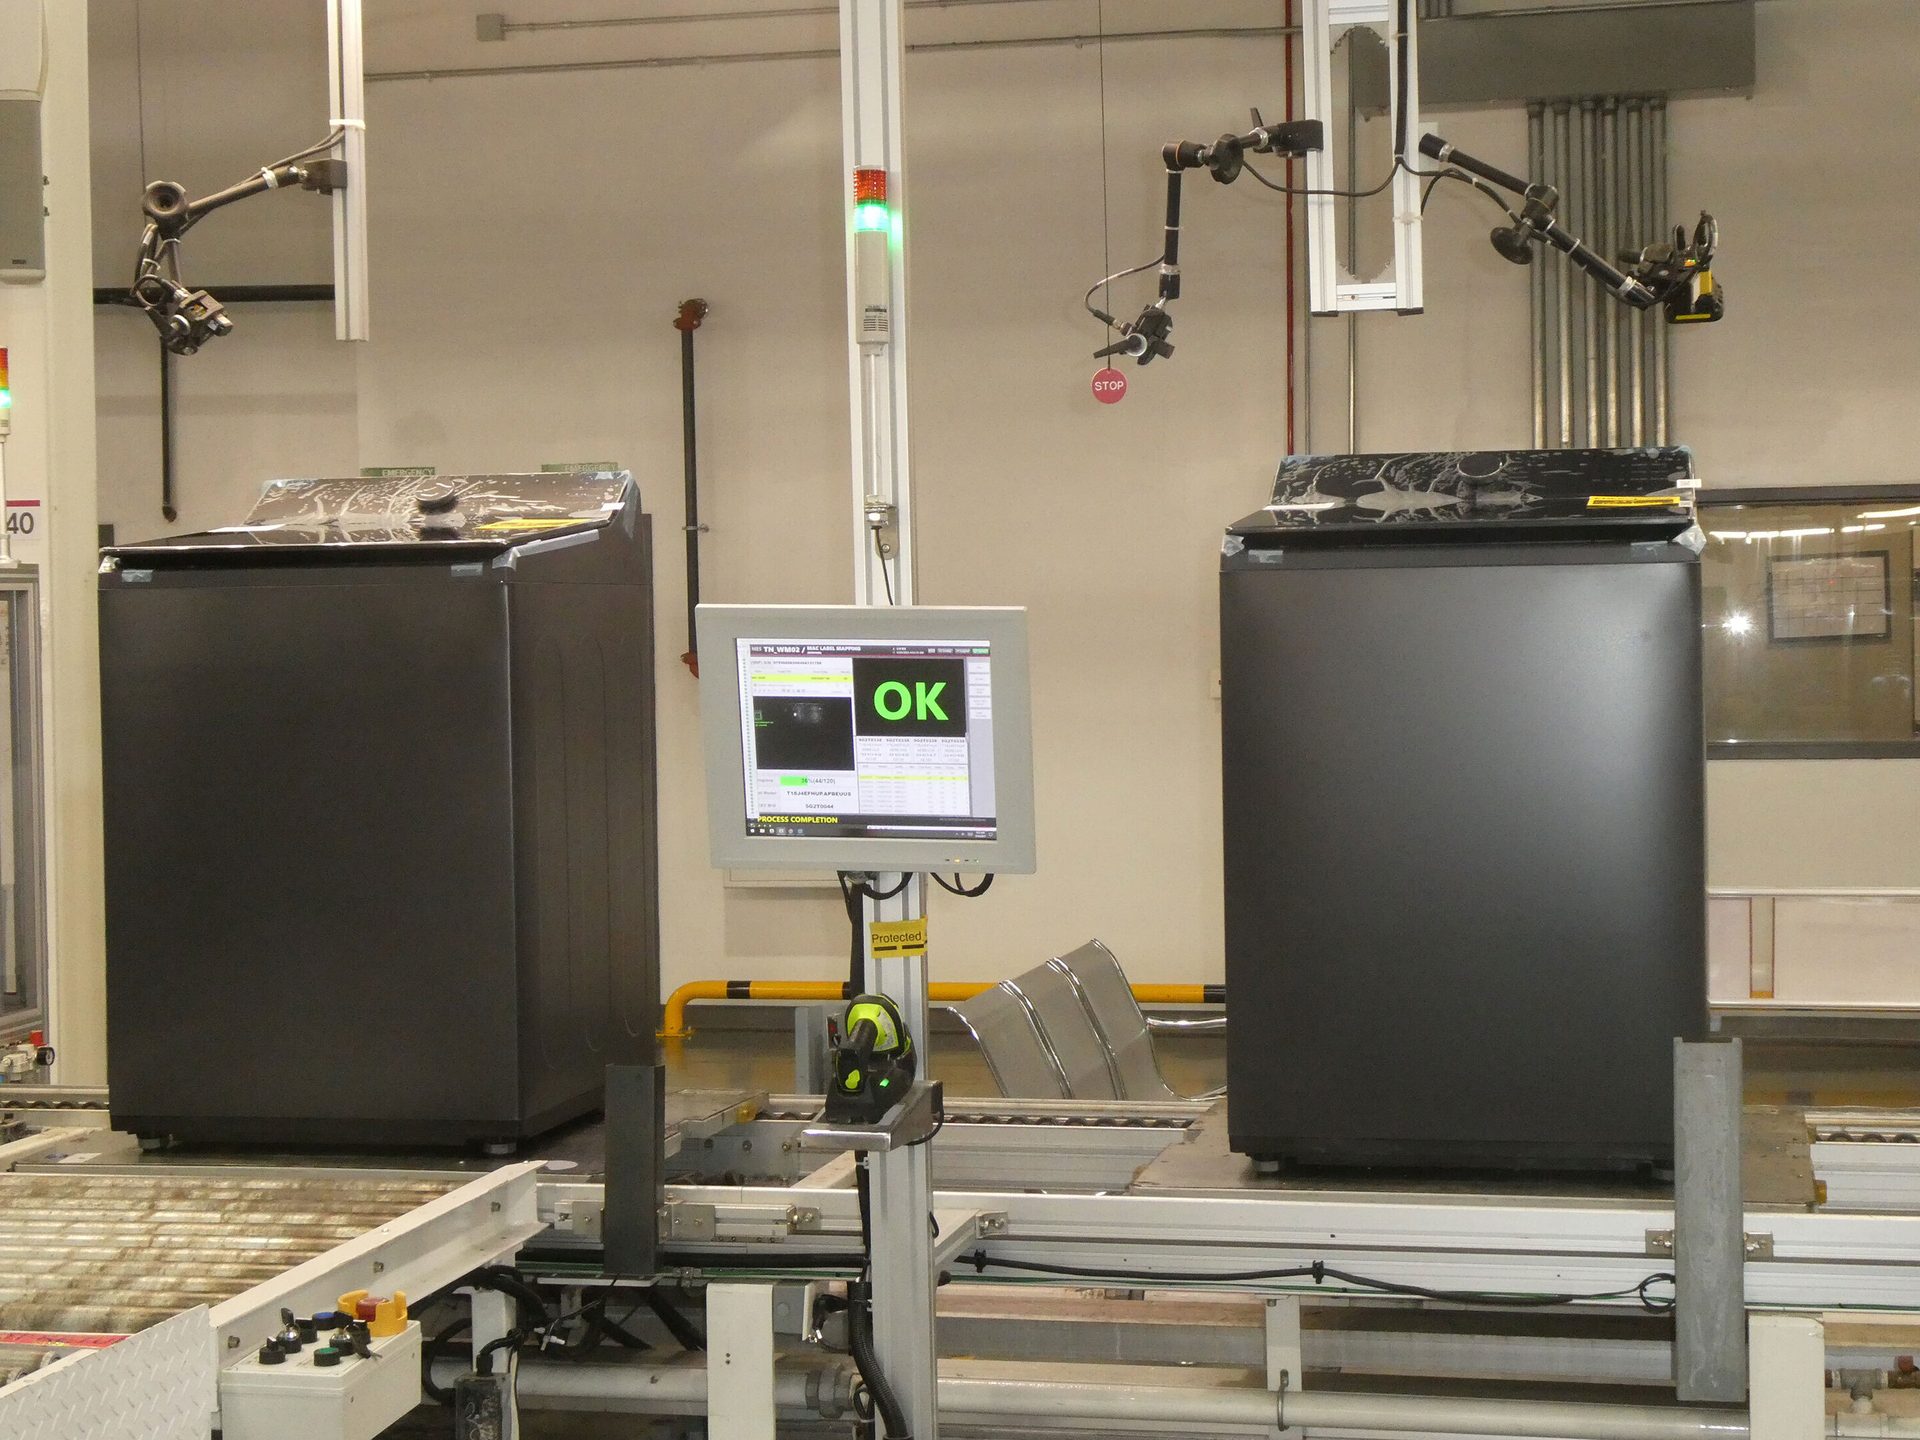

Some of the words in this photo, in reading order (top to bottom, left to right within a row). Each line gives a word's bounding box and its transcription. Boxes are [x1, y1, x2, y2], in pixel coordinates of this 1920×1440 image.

[1094, 380, 1124, 391] STOP
[382, 468, 434, 476] EMERGENCY
[6, 512, 34, 534] 40
[873, 681, 949, 720] OK
[872, 931, 922, 943] Protected
